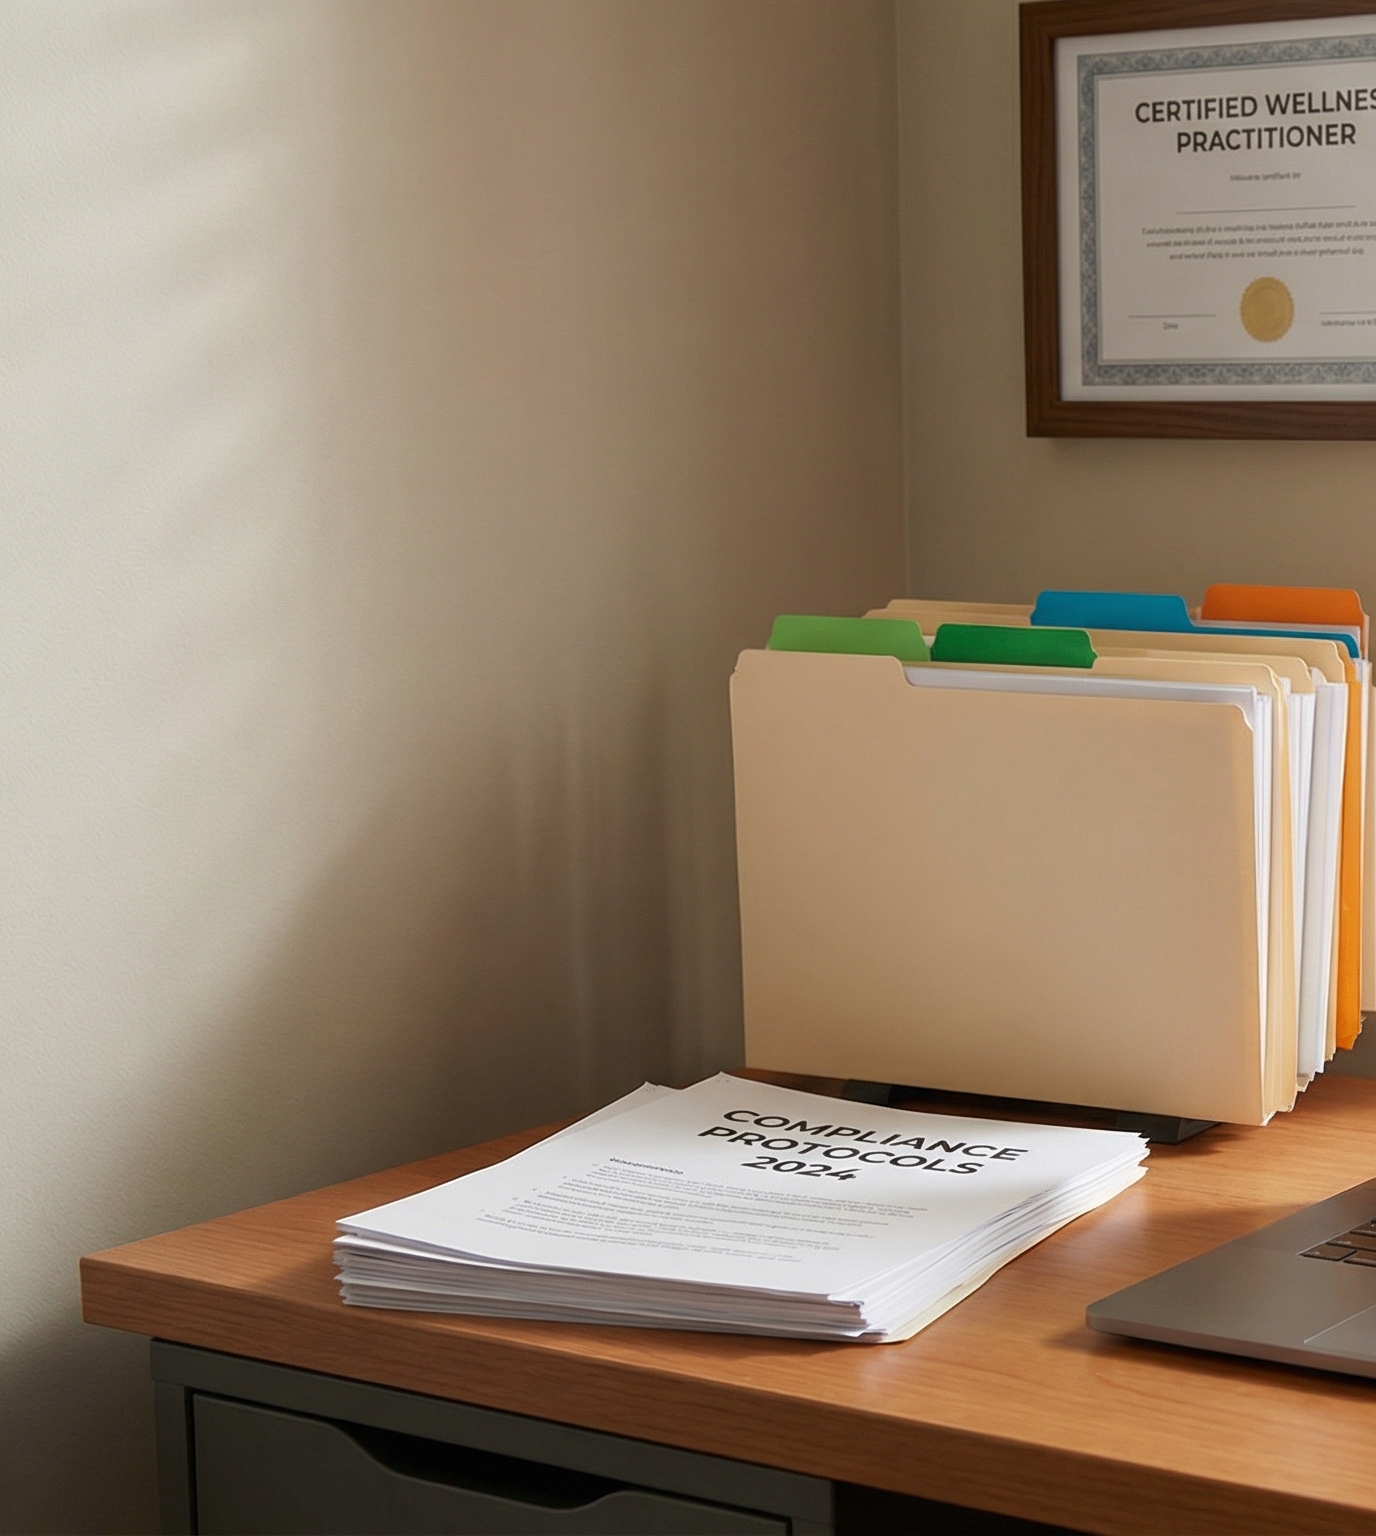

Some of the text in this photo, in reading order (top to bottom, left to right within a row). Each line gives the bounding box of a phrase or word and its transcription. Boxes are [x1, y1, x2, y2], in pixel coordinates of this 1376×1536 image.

[1135, 96, 1257, 123] CERTIFIED
[1178, 123, 1355, 153] PRACTITIONER
[723, 1110, 1029, 1160] COMPLIANCE
[697, 1126, 985, 1175] PROTOCOLS
[740, 1156, 860, 1181] 2024
